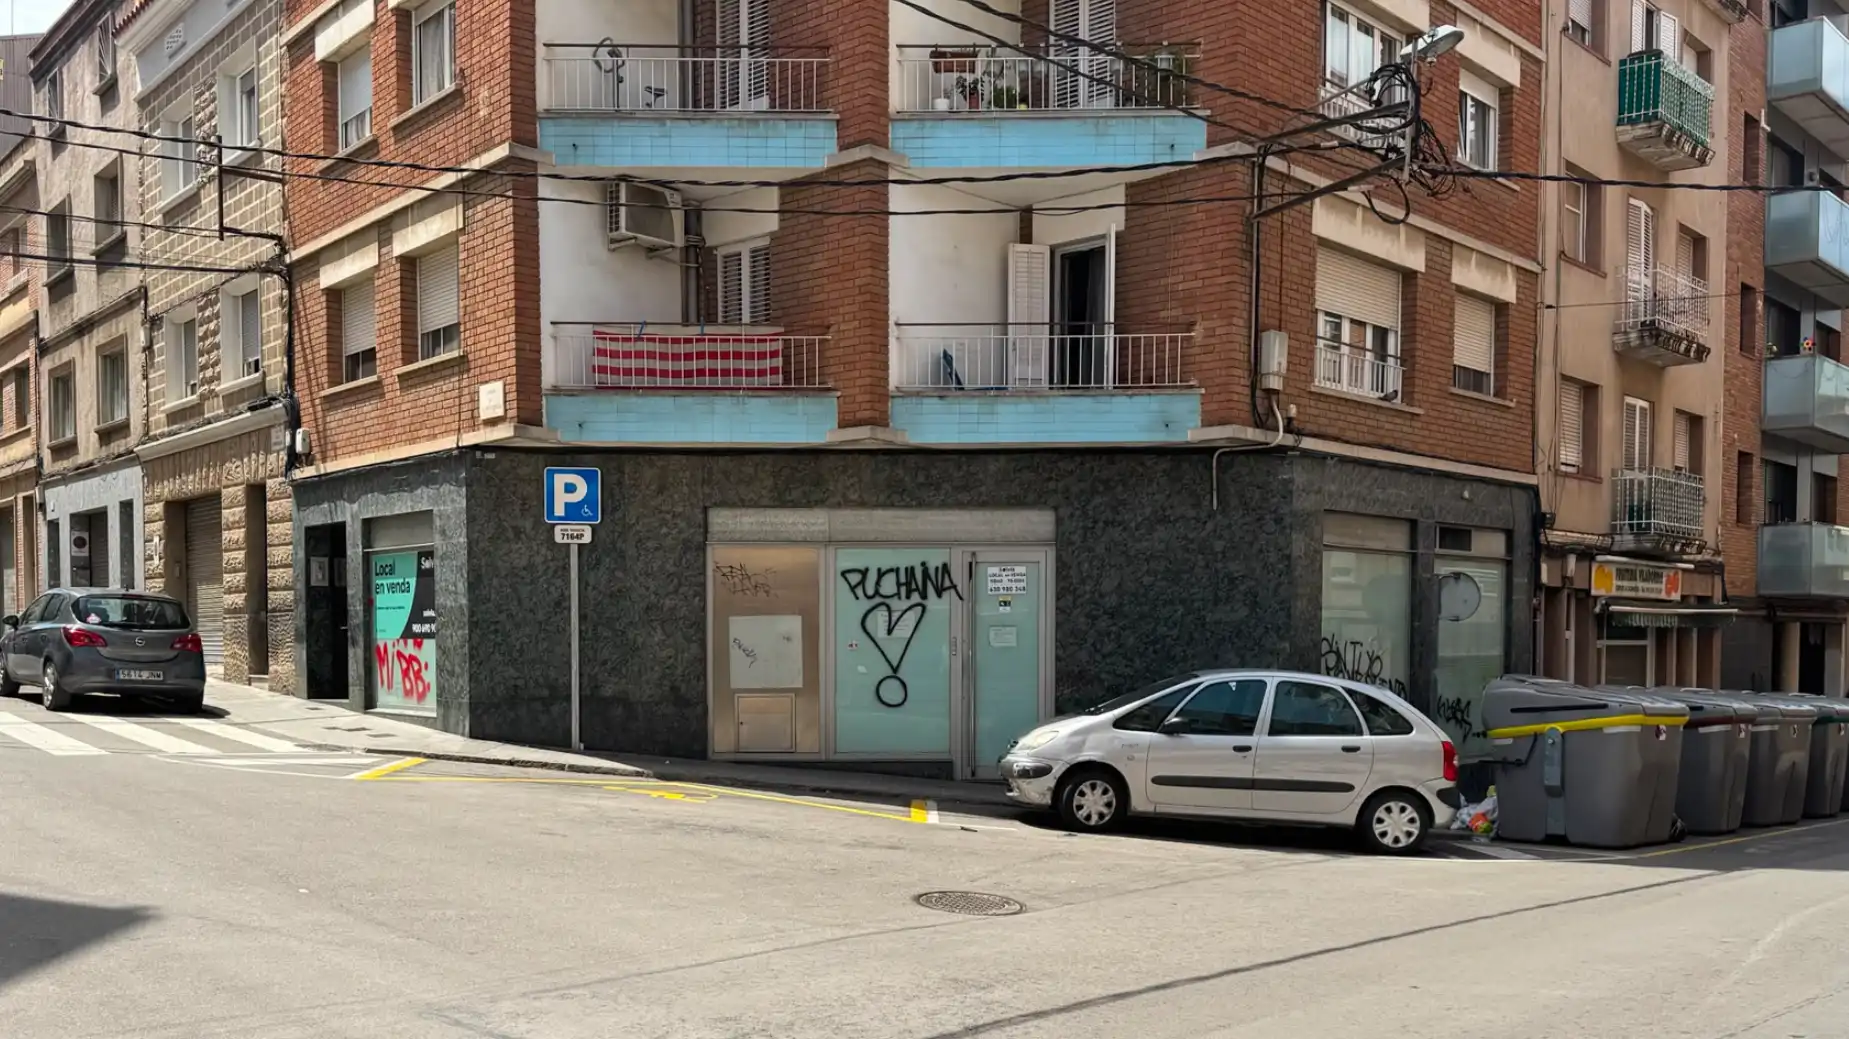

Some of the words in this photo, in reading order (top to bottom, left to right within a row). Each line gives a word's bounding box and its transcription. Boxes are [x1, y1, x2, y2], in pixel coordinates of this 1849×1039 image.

[554, 474, 587, 516] P
[561, 532, 584, 540] 7164P
[375, 558, 395, 576] Local
[375, 582, 385, 595] en
[386, 577, 411, 594] venda
